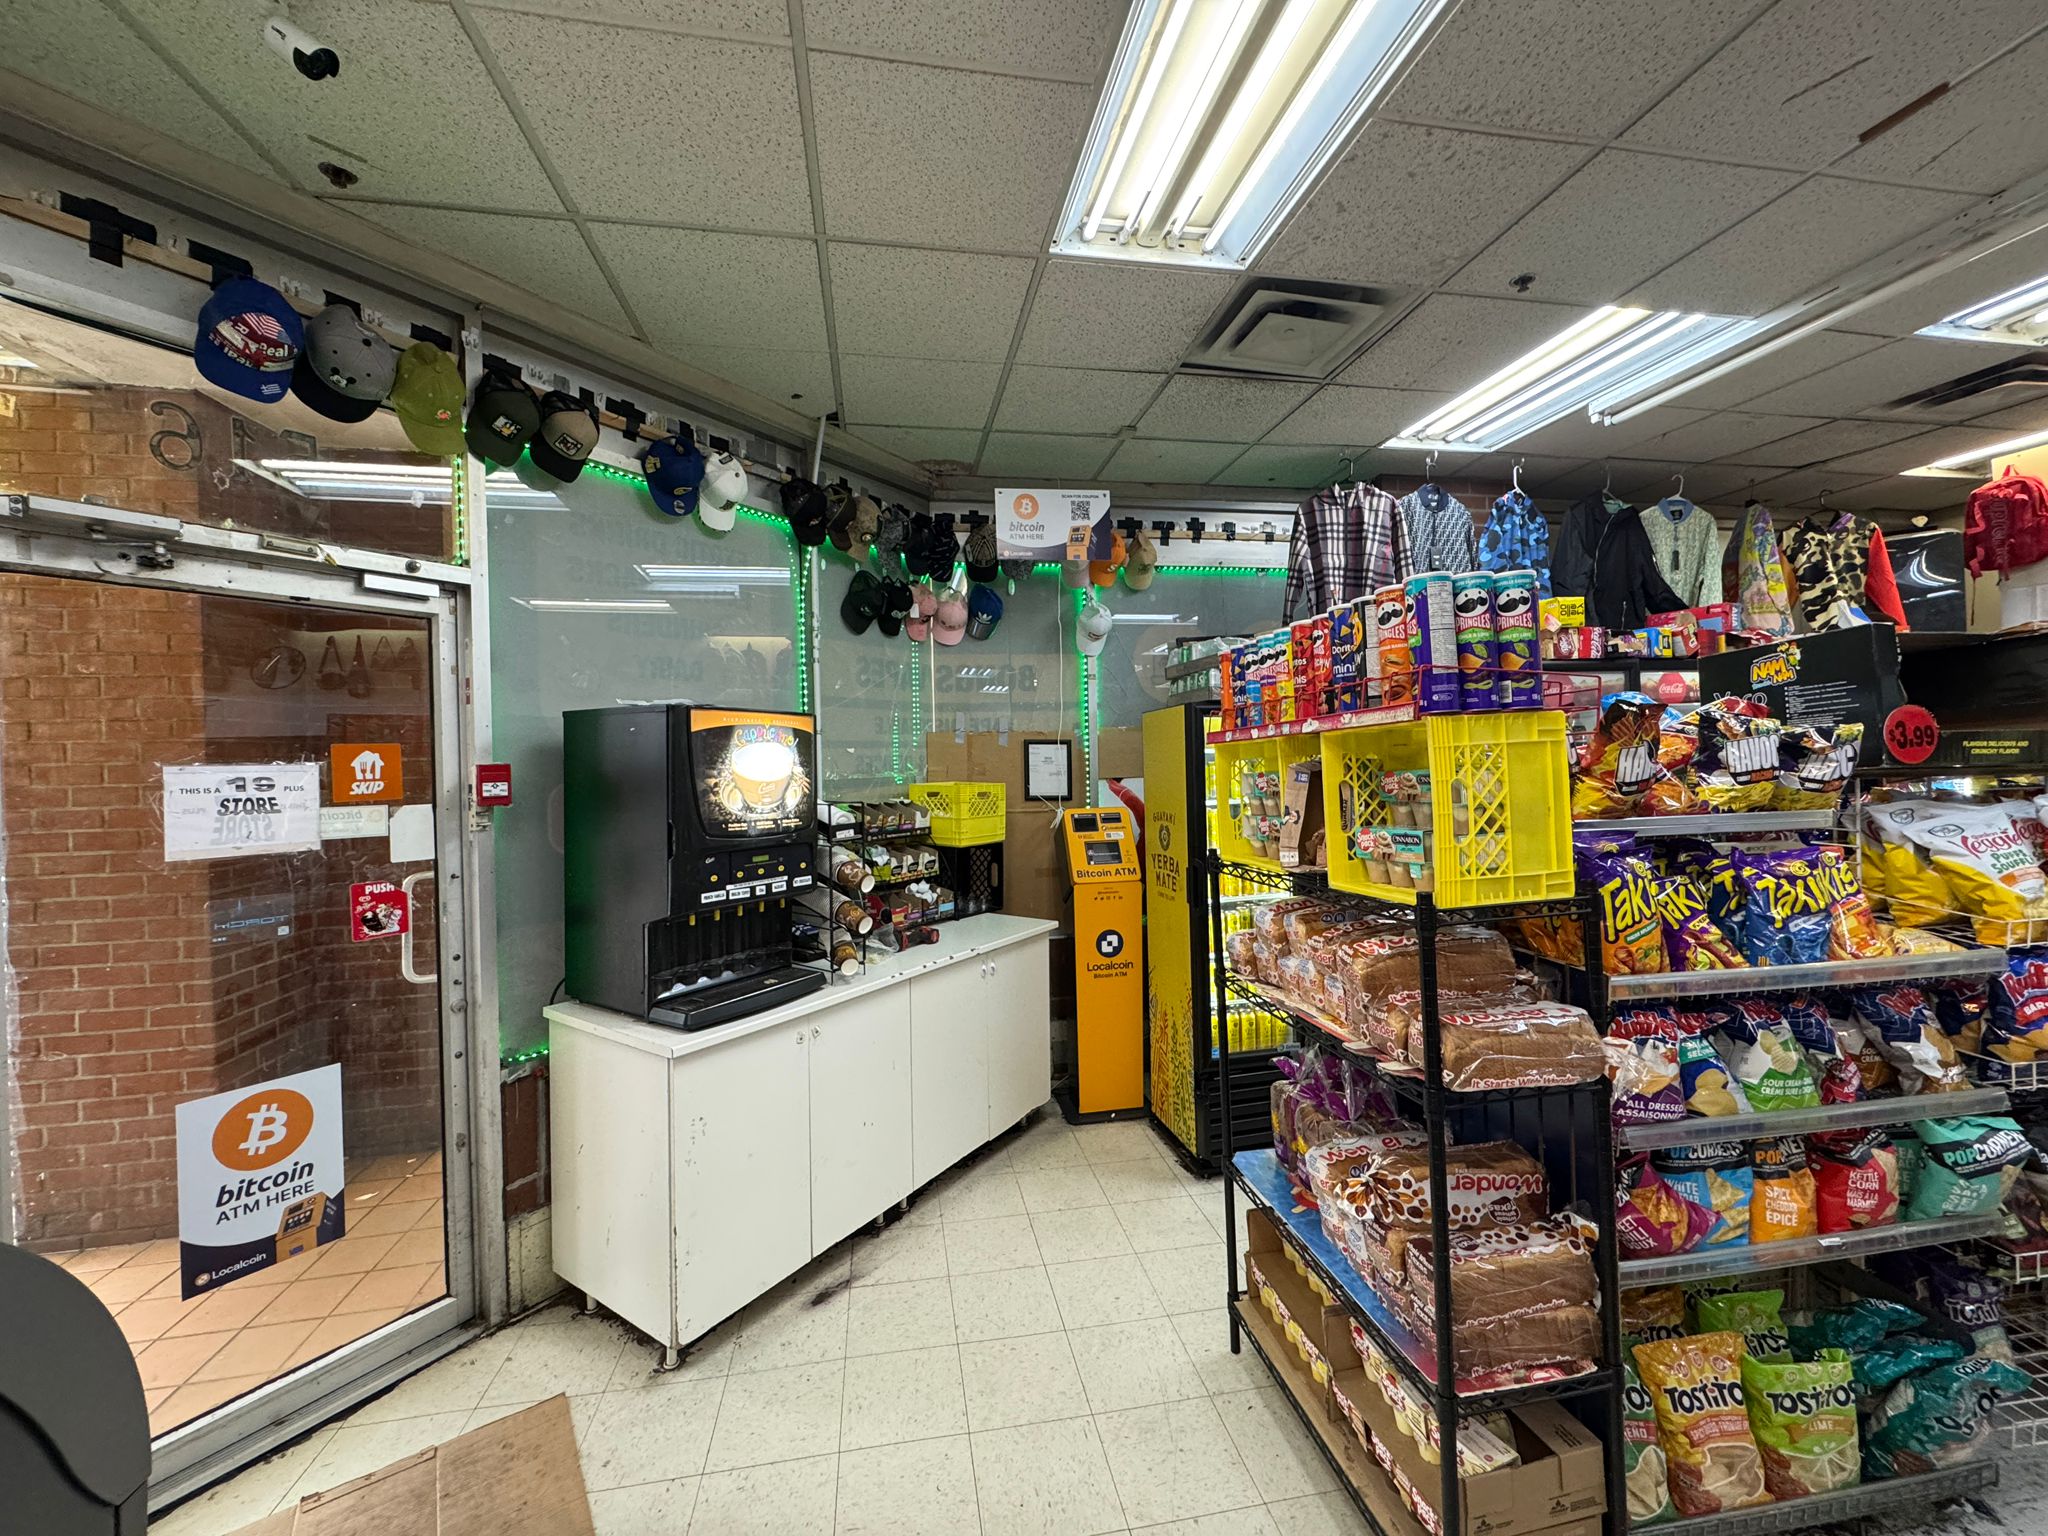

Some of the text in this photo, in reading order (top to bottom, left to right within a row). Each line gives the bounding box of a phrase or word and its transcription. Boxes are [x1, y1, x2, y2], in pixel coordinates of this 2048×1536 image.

[1009, 521, 1045, 532] bitcoin
[1456, 613, 1491, 630] PRINGLES
[1497, 613, 1532, 630] PRINGLES
[1888, 720, 1936, 750] $3.99
[179, 787, 200, 795] THIS
[350, 781, 385, 796] SKIP
[216, 797, 282, 817] STORE
[1392, 835, 1421, 844] CINNABON
[1150, 853, 1180, 877] YERBA
[1076, 867, 1138, 879] Bitcoin ATM
[1155, 870, 1177, 893] MATE
[365, 884, 395, 895] PUSH
[1086, 960, 1134, 973] Localcoin
[1093, 970, 1128, 979] Bitcoin ATM
[1482, 1077, 1516, 1089] Starts
[1763, 1078, 1783, 1087] SOUR
[1626, 1099, 1685, 1112] ALL DRESSED
[215, 1161, 315, 1208] bitcoin
[1450, 1173, 1543, 1196] Wonder
[1848, 1179, 1880, 1191] CORN
[216, 1179, 315, 1226] ATM HERE
[211, 1251, 267, 1280] Localcoin
[1809, 1421, 1834, 1431] LIME
